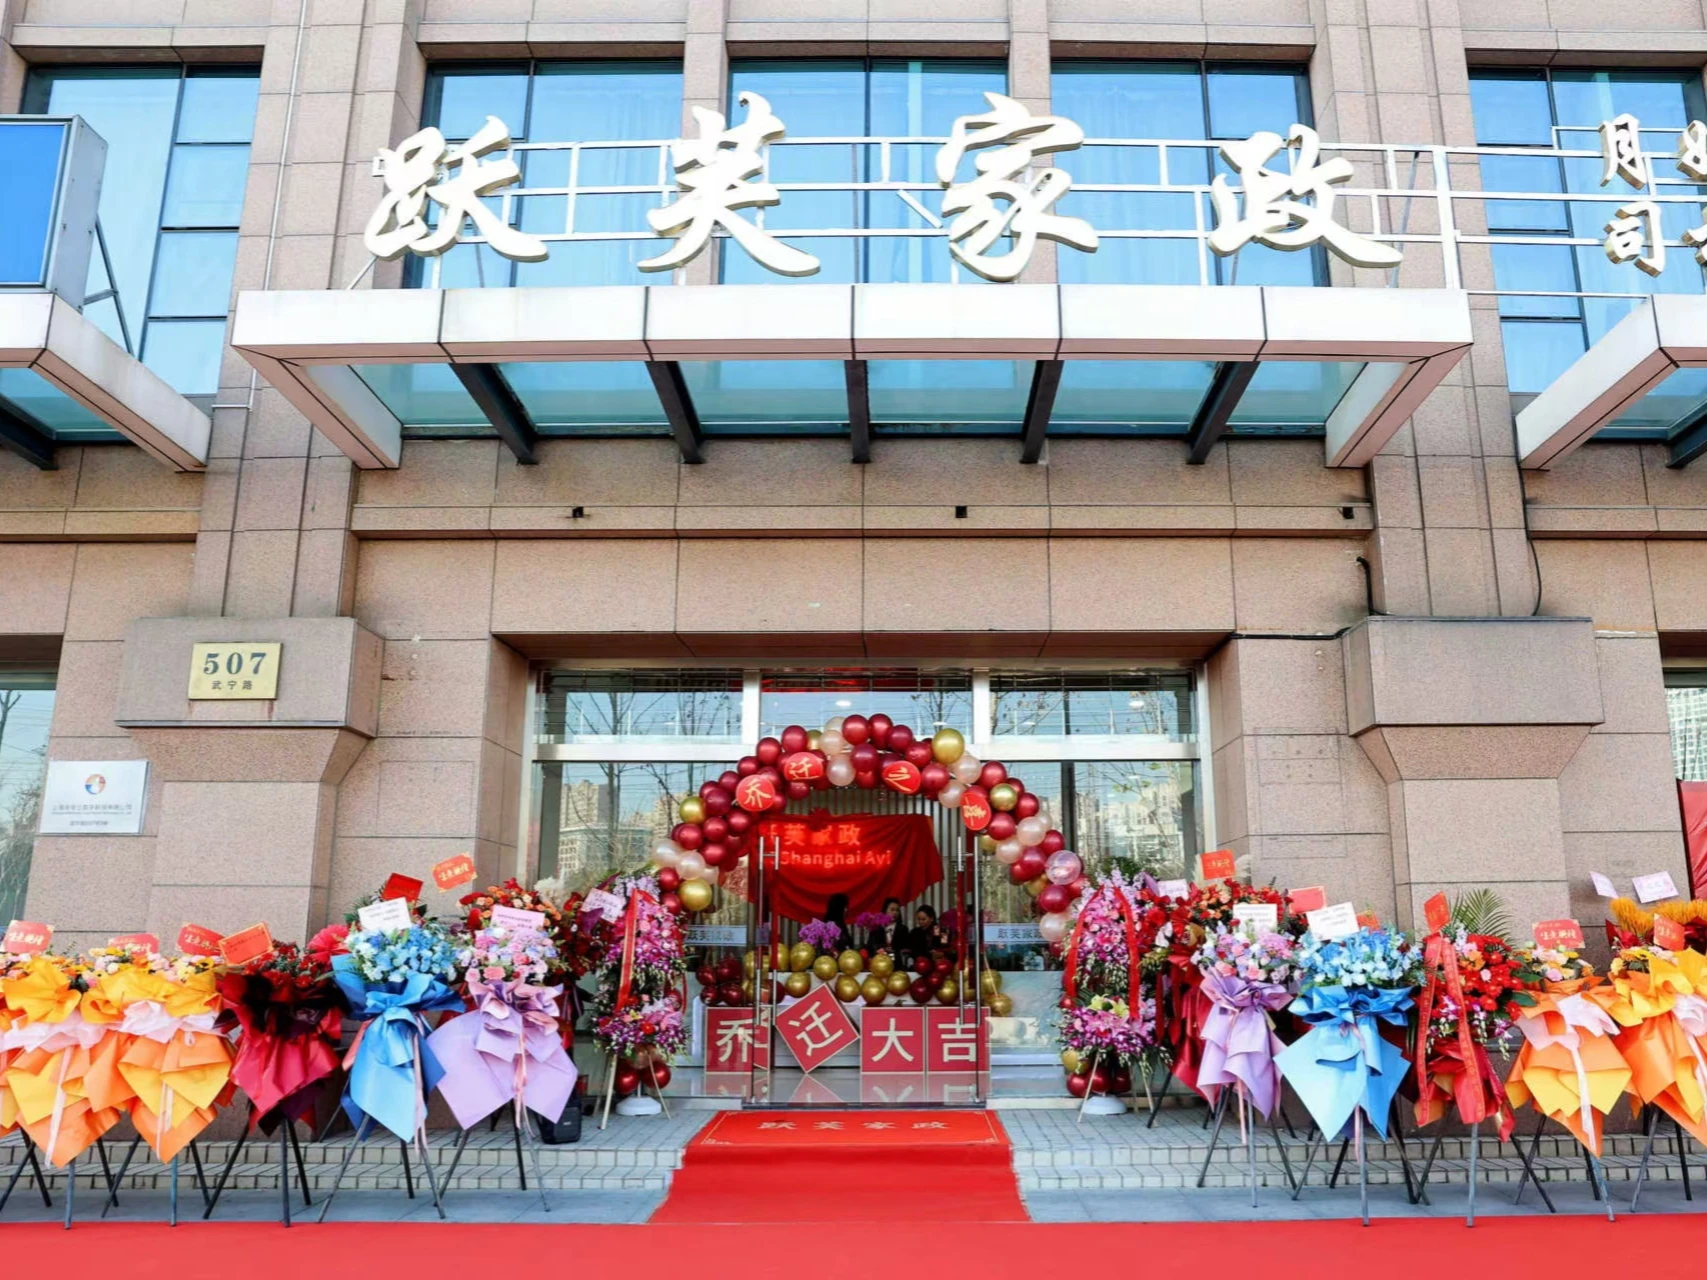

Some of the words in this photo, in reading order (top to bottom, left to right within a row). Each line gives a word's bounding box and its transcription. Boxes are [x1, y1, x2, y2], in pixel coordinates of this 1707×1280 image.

[203, 652, 266, 675] 507
[211, 680, 252, 690] 武宁路
[780, 850, 861, 869] Shanghai
[716, 1001, 977, 1063] 乔迁大吉
